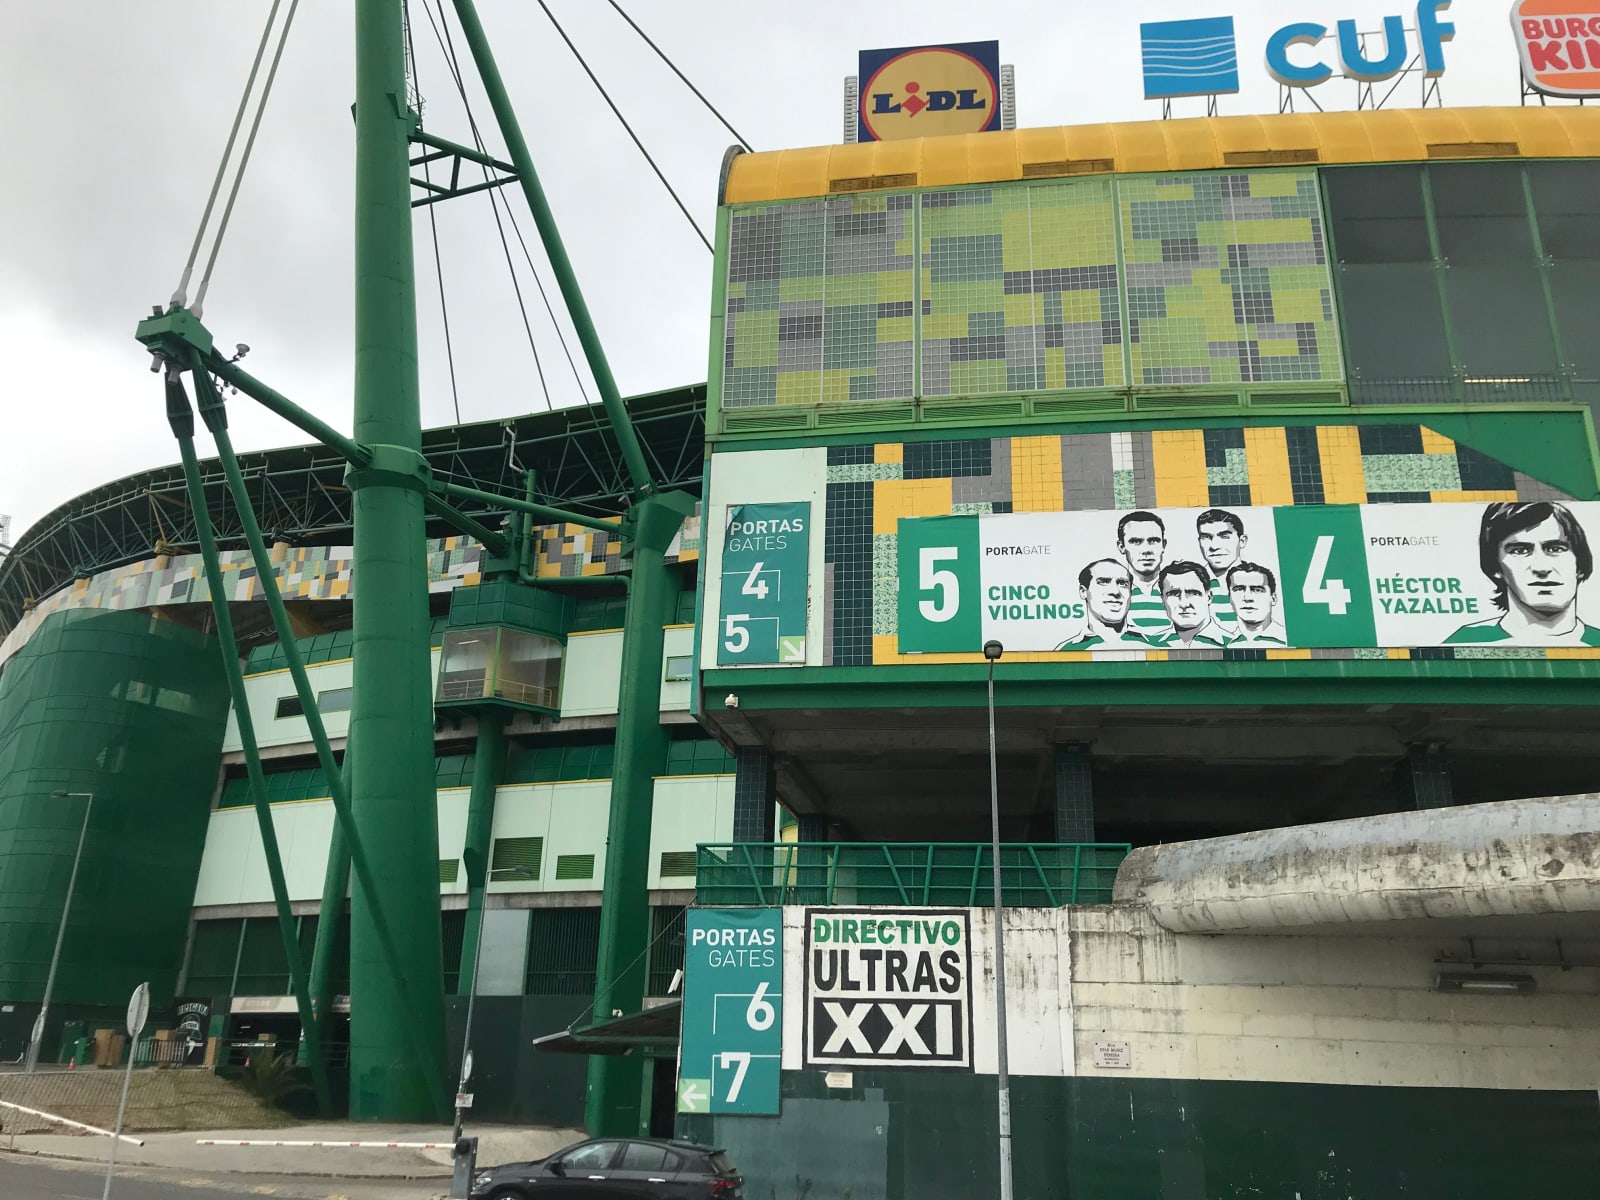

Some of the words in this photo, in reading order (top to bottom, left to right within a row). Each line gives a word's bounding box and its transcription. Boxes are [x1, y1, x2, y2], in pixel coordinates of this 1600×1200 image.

[729, 518, 804, 537] PORTAS
[729, 535, 788, 553] GATES
[741, 561, 769, 600] 4
[918, 546, 960, 623] 5
[1302, 535, 1352, 615] 4
[1376, 573, 1462, 594] HÉCTOR
[988, 585, 1050, 601] CINCO
[1379, 597, 1479, 614] YAZALDE
[988, 603, 1084, 621] VIOLINOS
[724, 613, 750, 653] 5
[692, 928, 776, 946] PORTAS
[814, 917, 961, 946] DIRECTIVO
[708, 949, 775, 968] GATES
[813, 948, 961, 994] ULTRAS
[746, 981, 776, 1031] 6
[821, 1001, 955, 1056] XXI
[720, 1051, 751, 1103] 7
